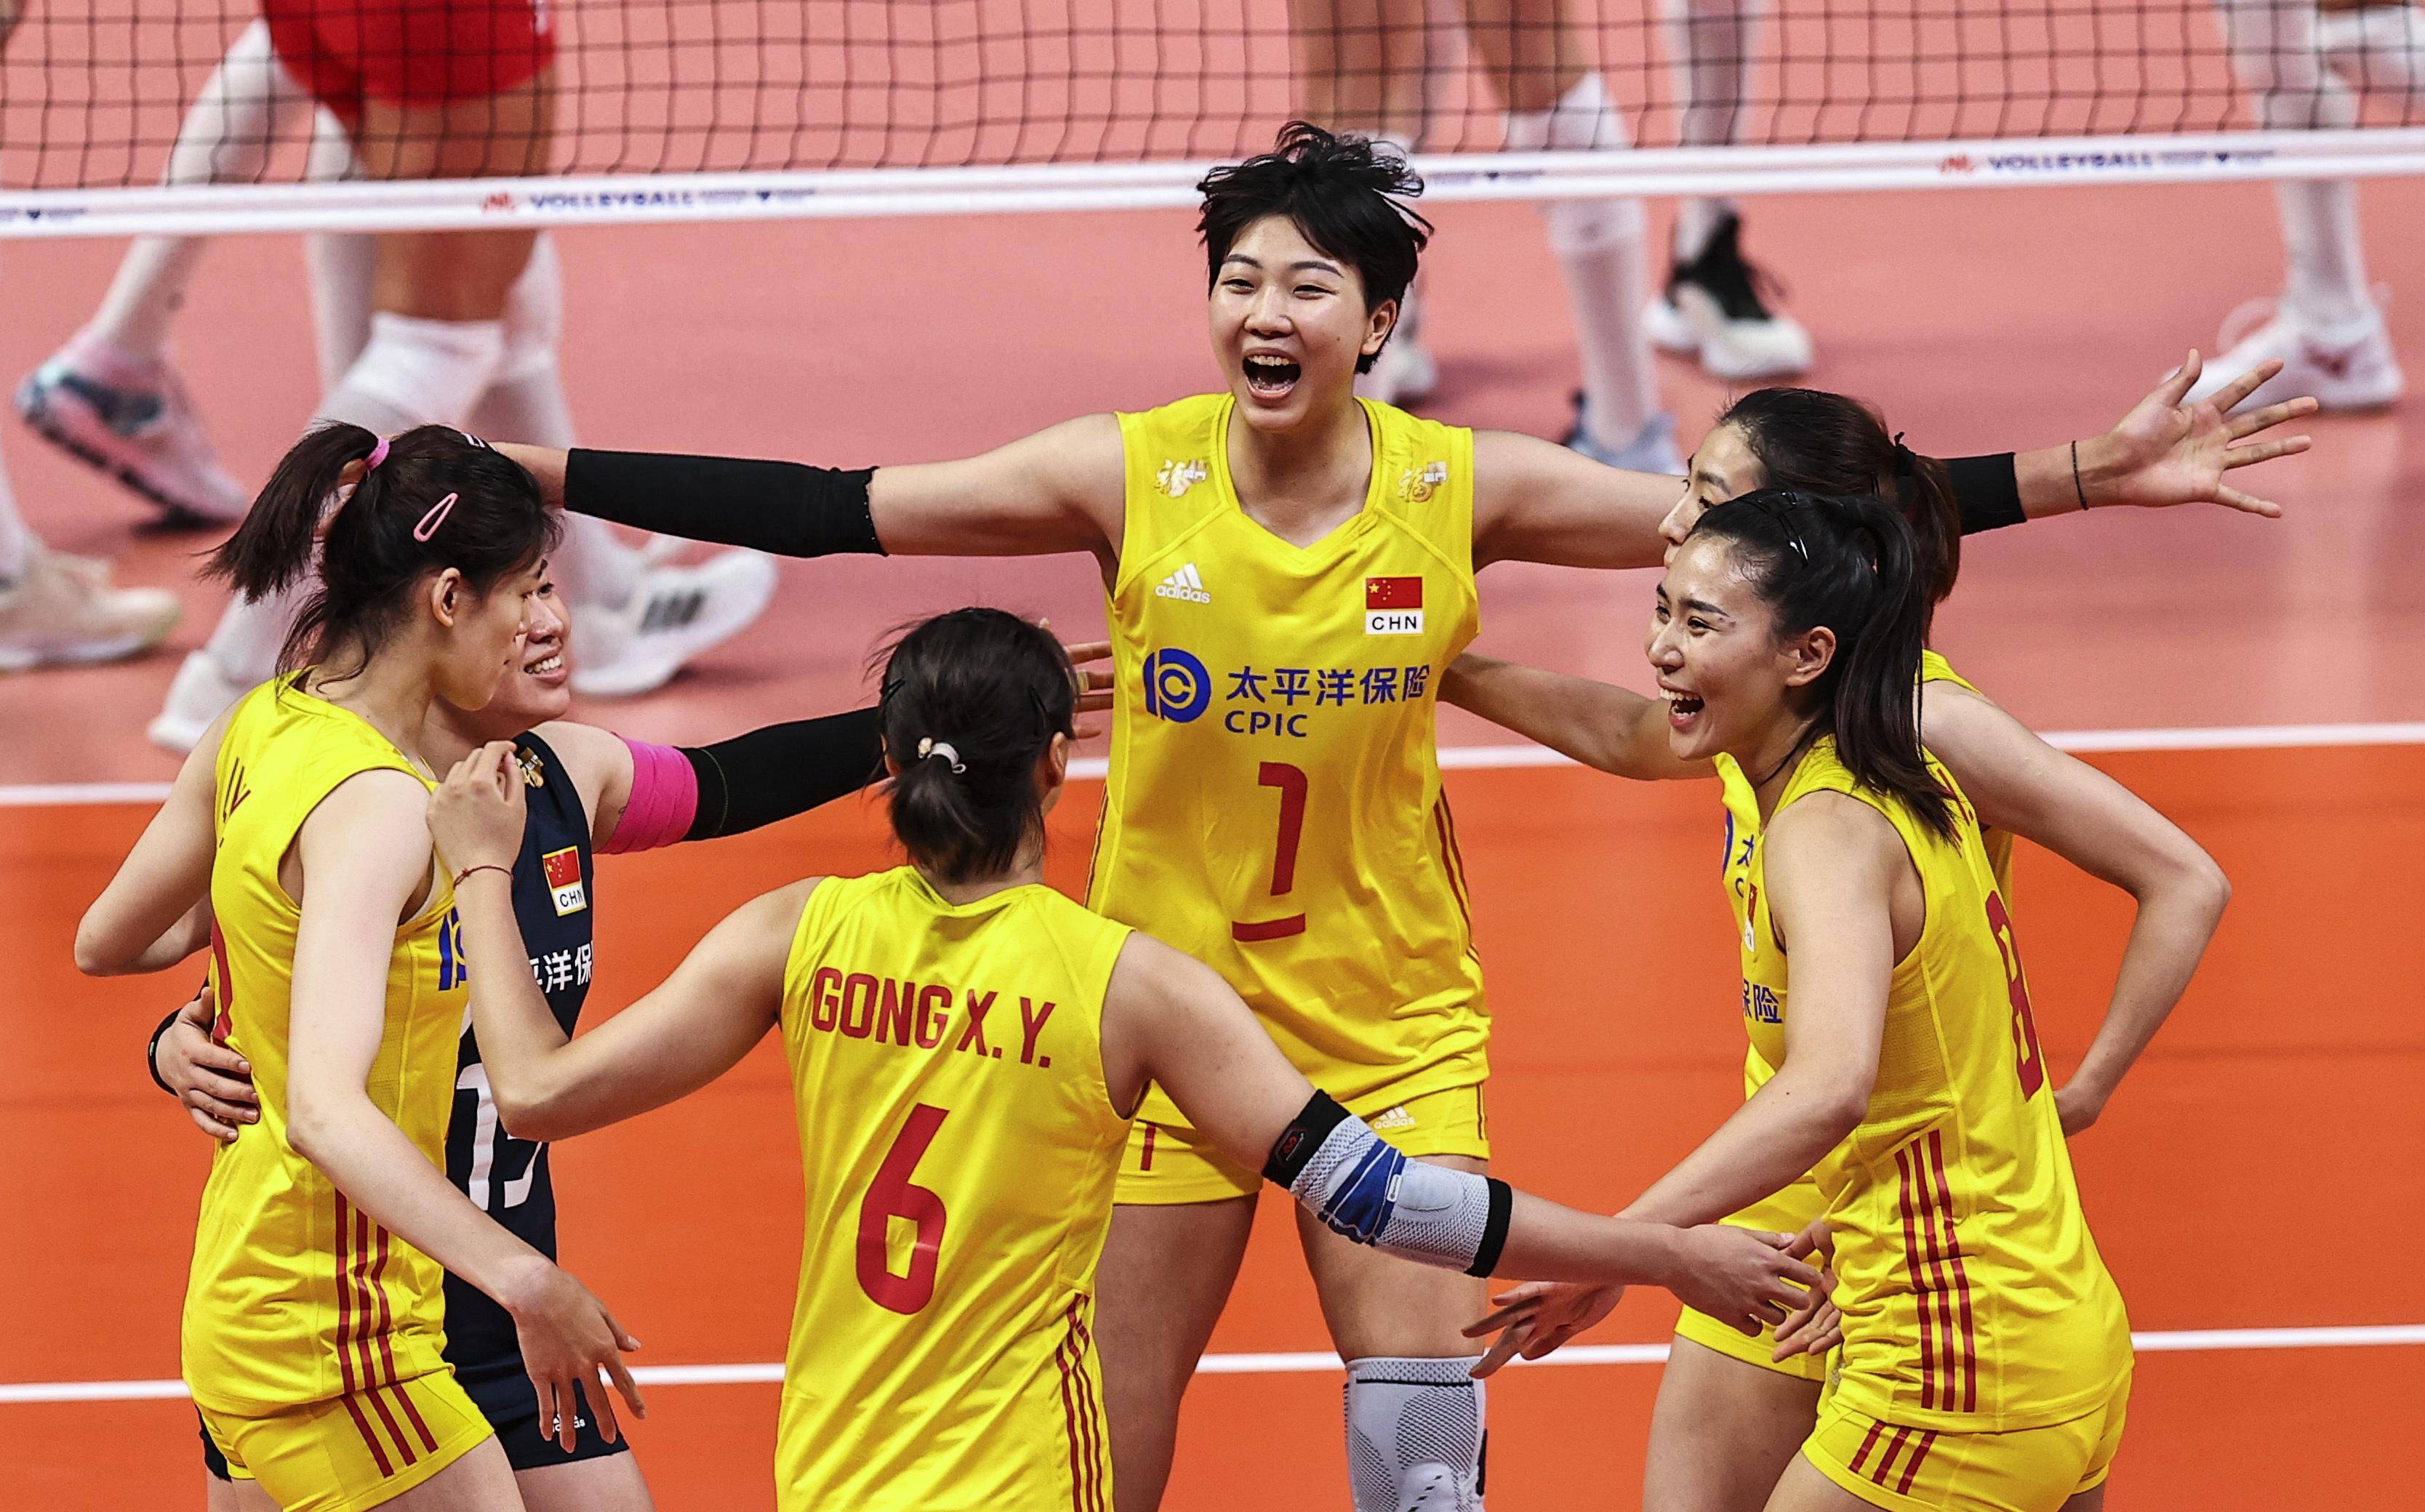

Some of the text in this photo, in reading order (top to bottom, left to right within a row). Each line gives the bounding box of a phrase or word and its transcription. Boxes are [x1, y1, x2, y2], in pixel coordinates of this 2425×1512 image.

[1989, 151, 2152, 170] VOLLEYBALL
[530, 190, 694, 209] VOLLEYBALL
[1155, 584, 1211, 603] adidas
[1371, 616, 1416, 631] CHN
[1226, 665, 1430, 706] 太平洋保险
[1224, 710, 1307, 737] CPIC
[559, 890, 583, 907] CHN
[811, 967, 952, 1049] GONG
[856, 1102, 950, 1316] 6
